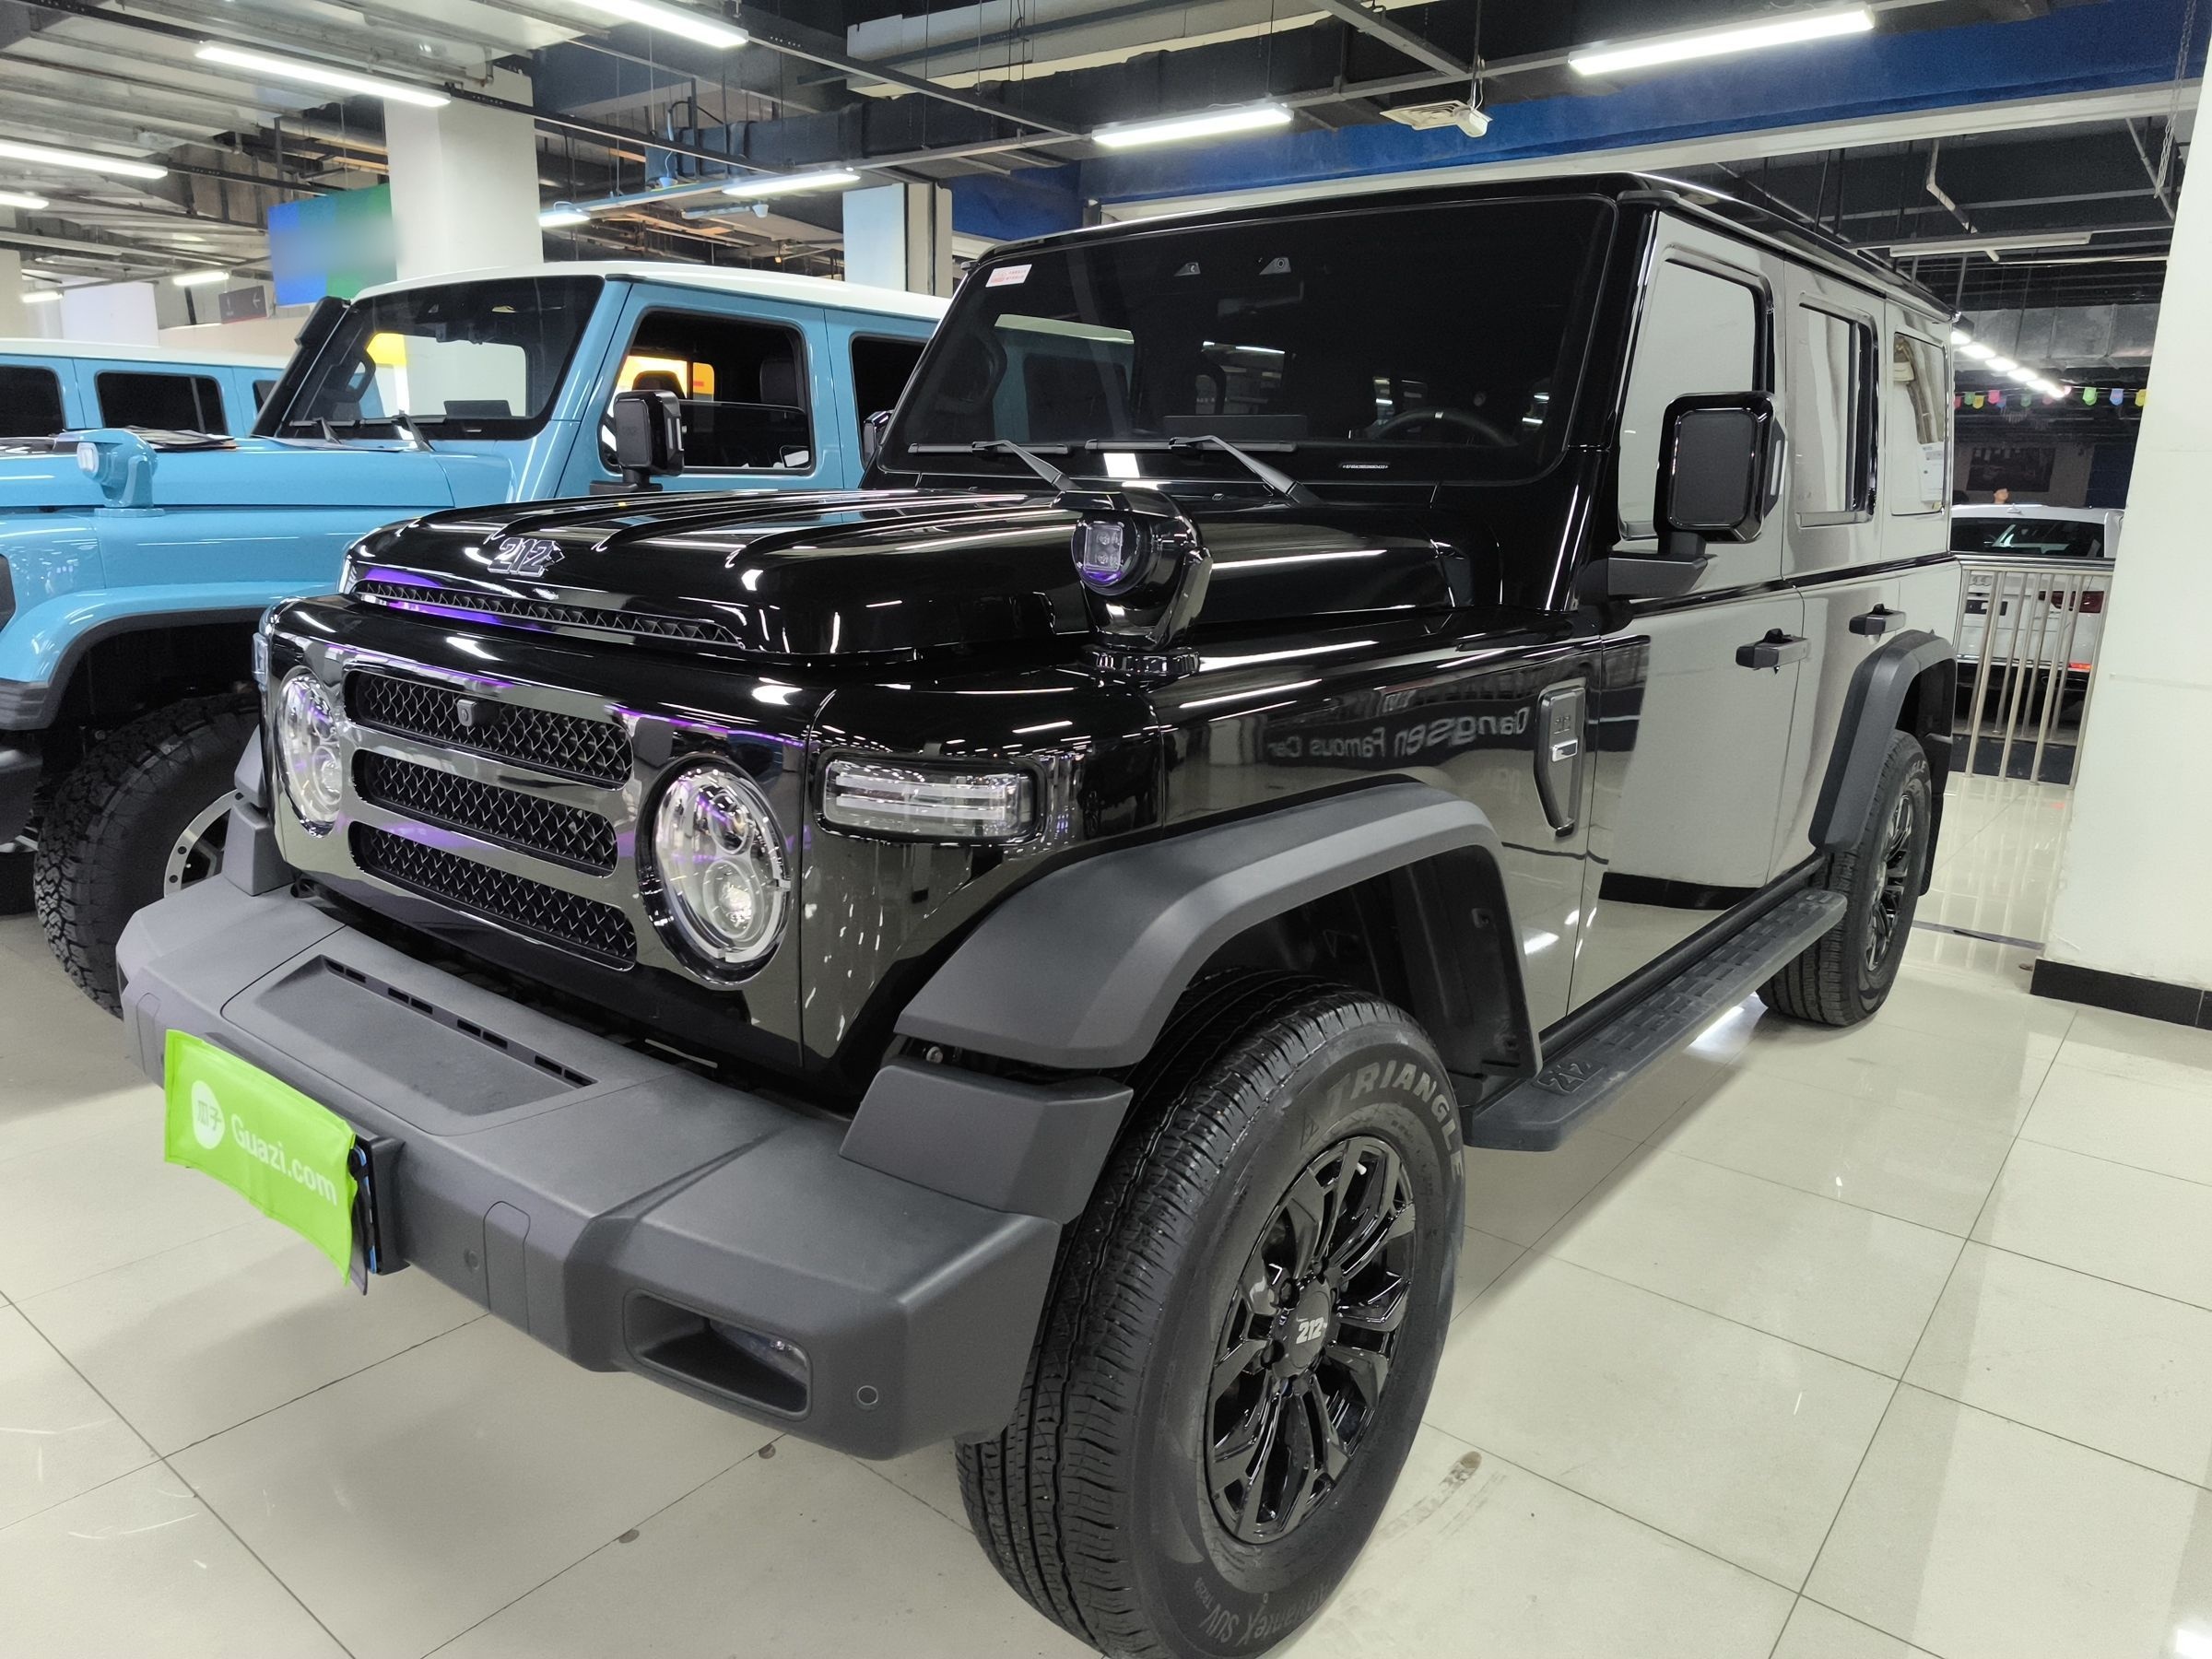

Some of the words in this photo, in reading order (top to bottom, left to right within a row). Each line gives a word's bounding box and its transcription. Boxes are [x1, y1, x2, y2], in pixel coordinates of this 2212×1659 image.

[488, 537, 556, 577] 212
[197, 1099, 222, 1131] 瓜子
[1325, 1059, 1465, 1182] TRIANGLE
[230, 1113, 337, 1206] Guazi.com
[1295, 1316, 1324, 1345] 212
[1198, 1603, 1240, 1643] SUV
